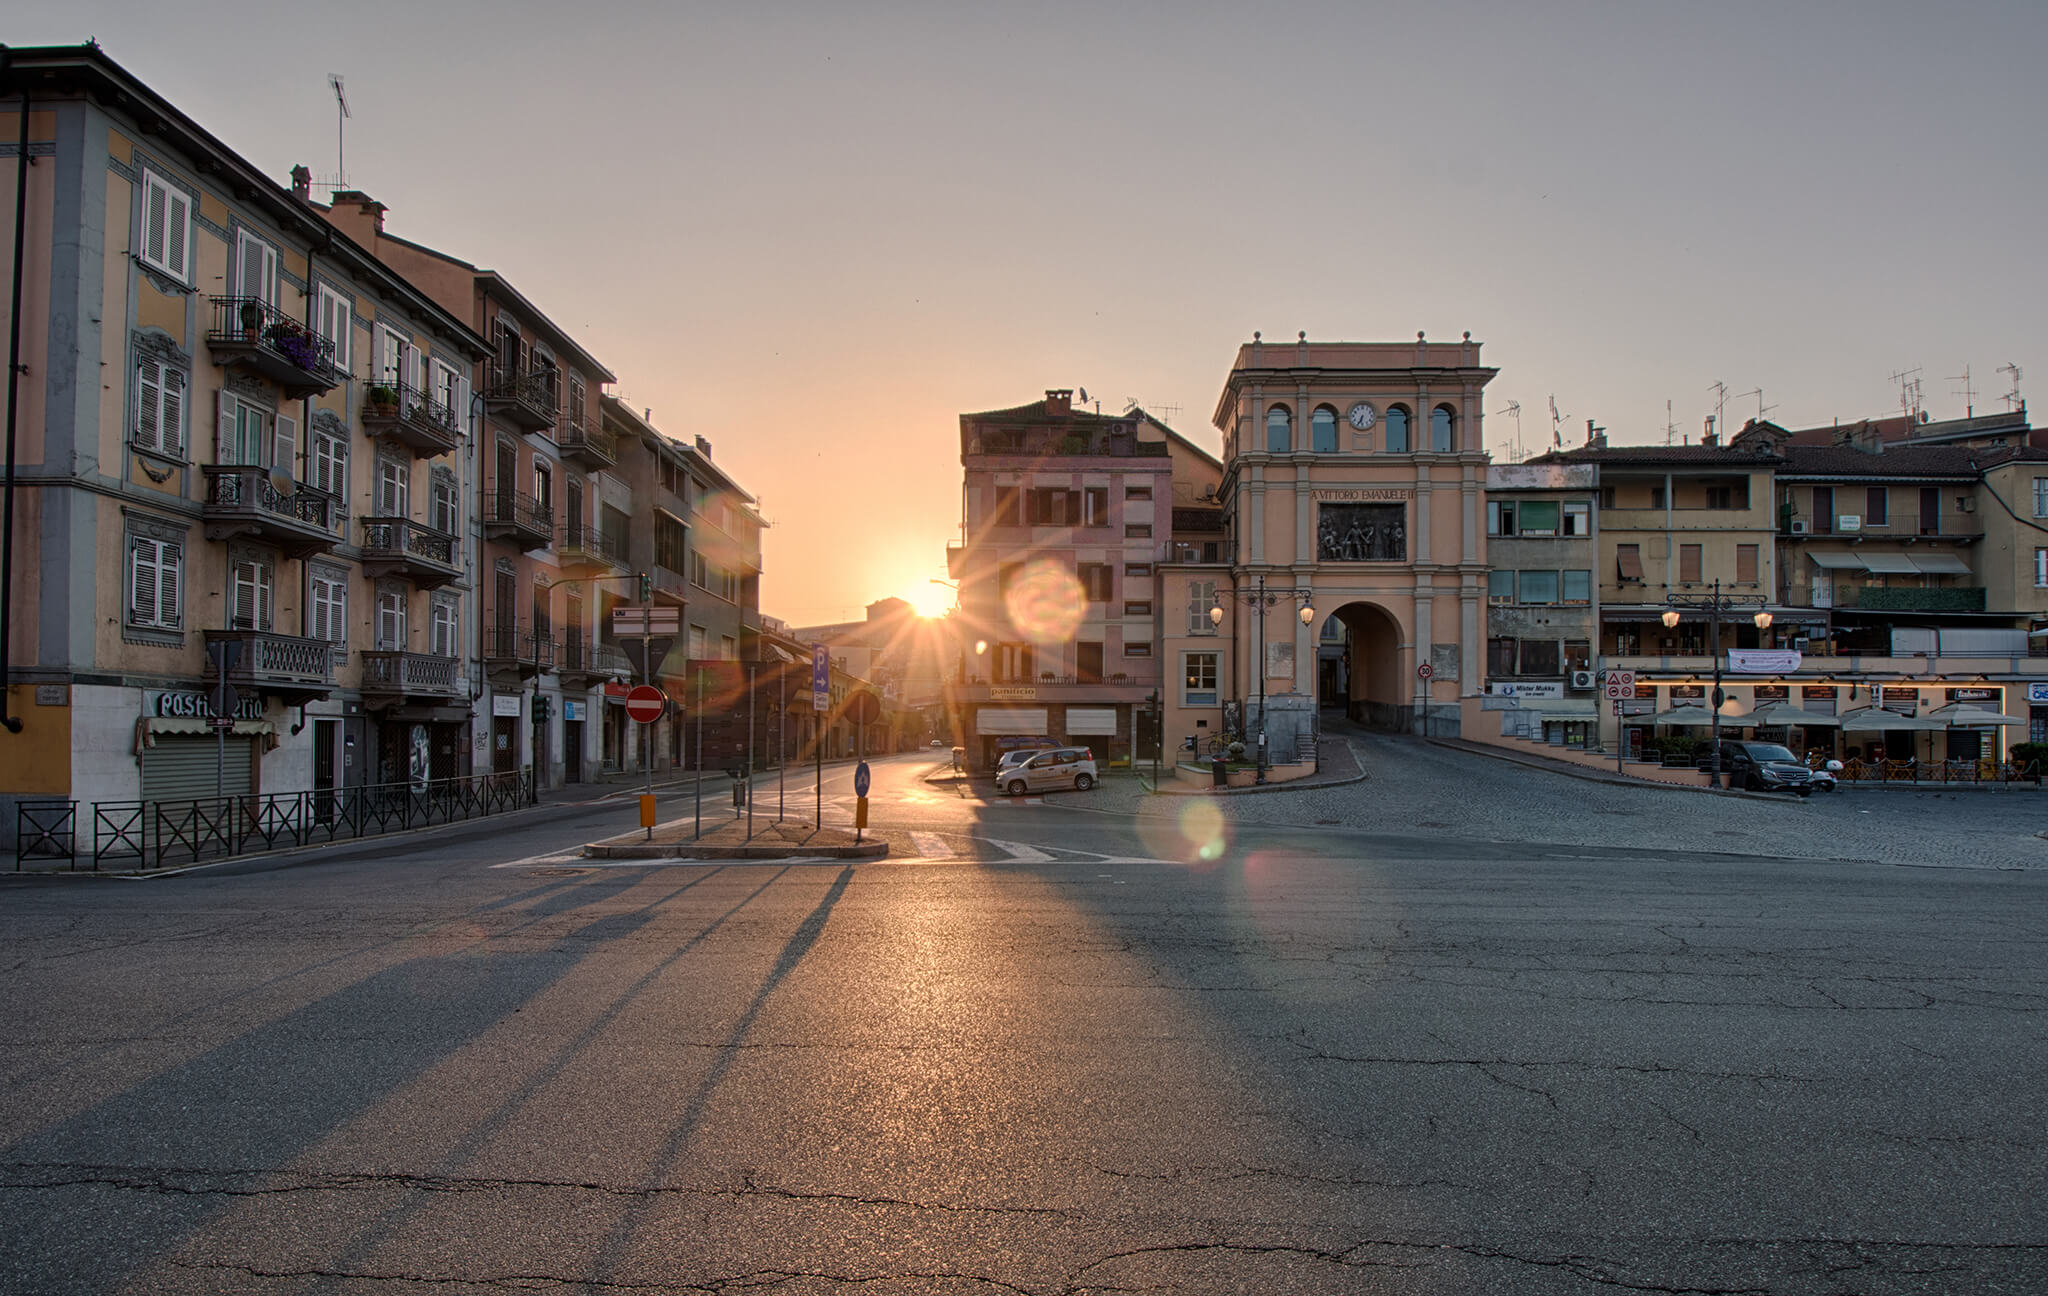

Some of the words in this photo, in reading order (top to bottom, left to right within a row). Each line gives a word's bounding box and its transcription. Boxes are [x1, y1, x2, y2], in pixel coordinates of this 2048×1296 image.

[1311, 490, 1317, 500] A
[1319, 490, 1358, 500] VITTORIO
[1361, 490, 1406, 500] EMANUELE
[1408, 490, 1414, 500] II
